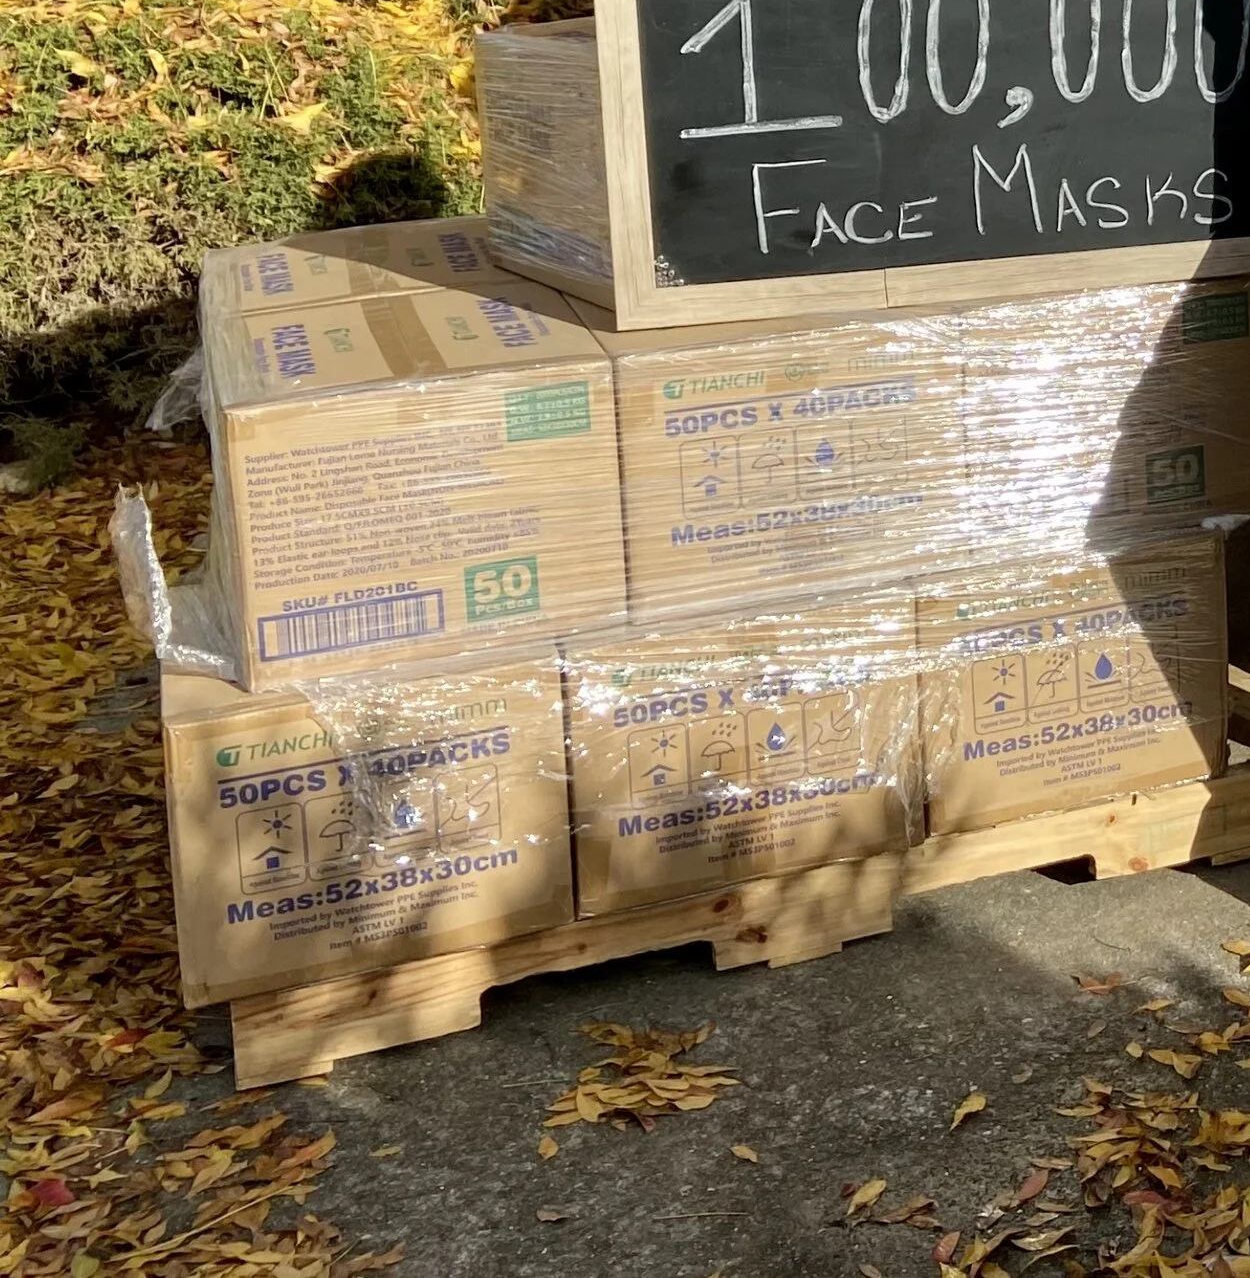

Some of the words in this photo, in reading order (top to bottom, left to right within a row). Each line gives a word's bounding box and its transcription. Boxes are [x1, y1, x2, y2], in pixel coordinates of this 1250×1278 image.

[690, 371, 766, 394] TIANCHI
[665, 406, 758, 438] 50PCS
[767, 402, 783, 421] X
[245, 453, 288, 465] Supplier:
[291, 444, 349, 457] Watchtower
[249, 510, 288, 521] Product
[251, 533, 291, 544] Product
[252, 544, 292, 555] Product
[253, 557, 274, 566] 13%
[277, 553, 309, 563] Elastic
[254, 567, 292, 579] Storage
[254, 576, 310, 590] Production
[342, 562, 399, 577] 2020/07/10
[474, 564, 532, 604] 50
[282, 594, 328, 612] SKU#
[613, 691, 708, 729] 50PCS
[718, 687, 735, 709] X
[963, 702, 1193, 761] Meas:52x38x30cm
[247, 732, 334, 761] TIANCHI
[996, 752, 1034, 767] Imported
[1048, 740, 1095, 756] Watchtower
[219, 769, 326, 809] 50PCS
[368, 732, 511, 777] 40PACKS
[1000, 763, 1044, 777] Distributed
[1061, 763, 1084, 773] ASTM
[655, 829, 698, 845] Imported
[713, 815, 766, 832] Watchtower
[787, 803, 824, 818] Supplies
[659, 839, 709, 854] Distributed
[780, 813, 824, 829] Maximum
[729, 838, 754, 848] ASTM
[708, 854, 728, 864] Item
[227, 849, 518, 925] Meas:52x38x30cm
[269, 914, 317, 931] Imported
[335, 899, 394, 917] Watchtower
[418, 882, 459, 900] Supplies
[274, 925, 330, 941] Distributed
[348, 909, 396, 926] Minimum
[352, 923, 381, 936] ASTM
[329, 940, 352, 951] Item
